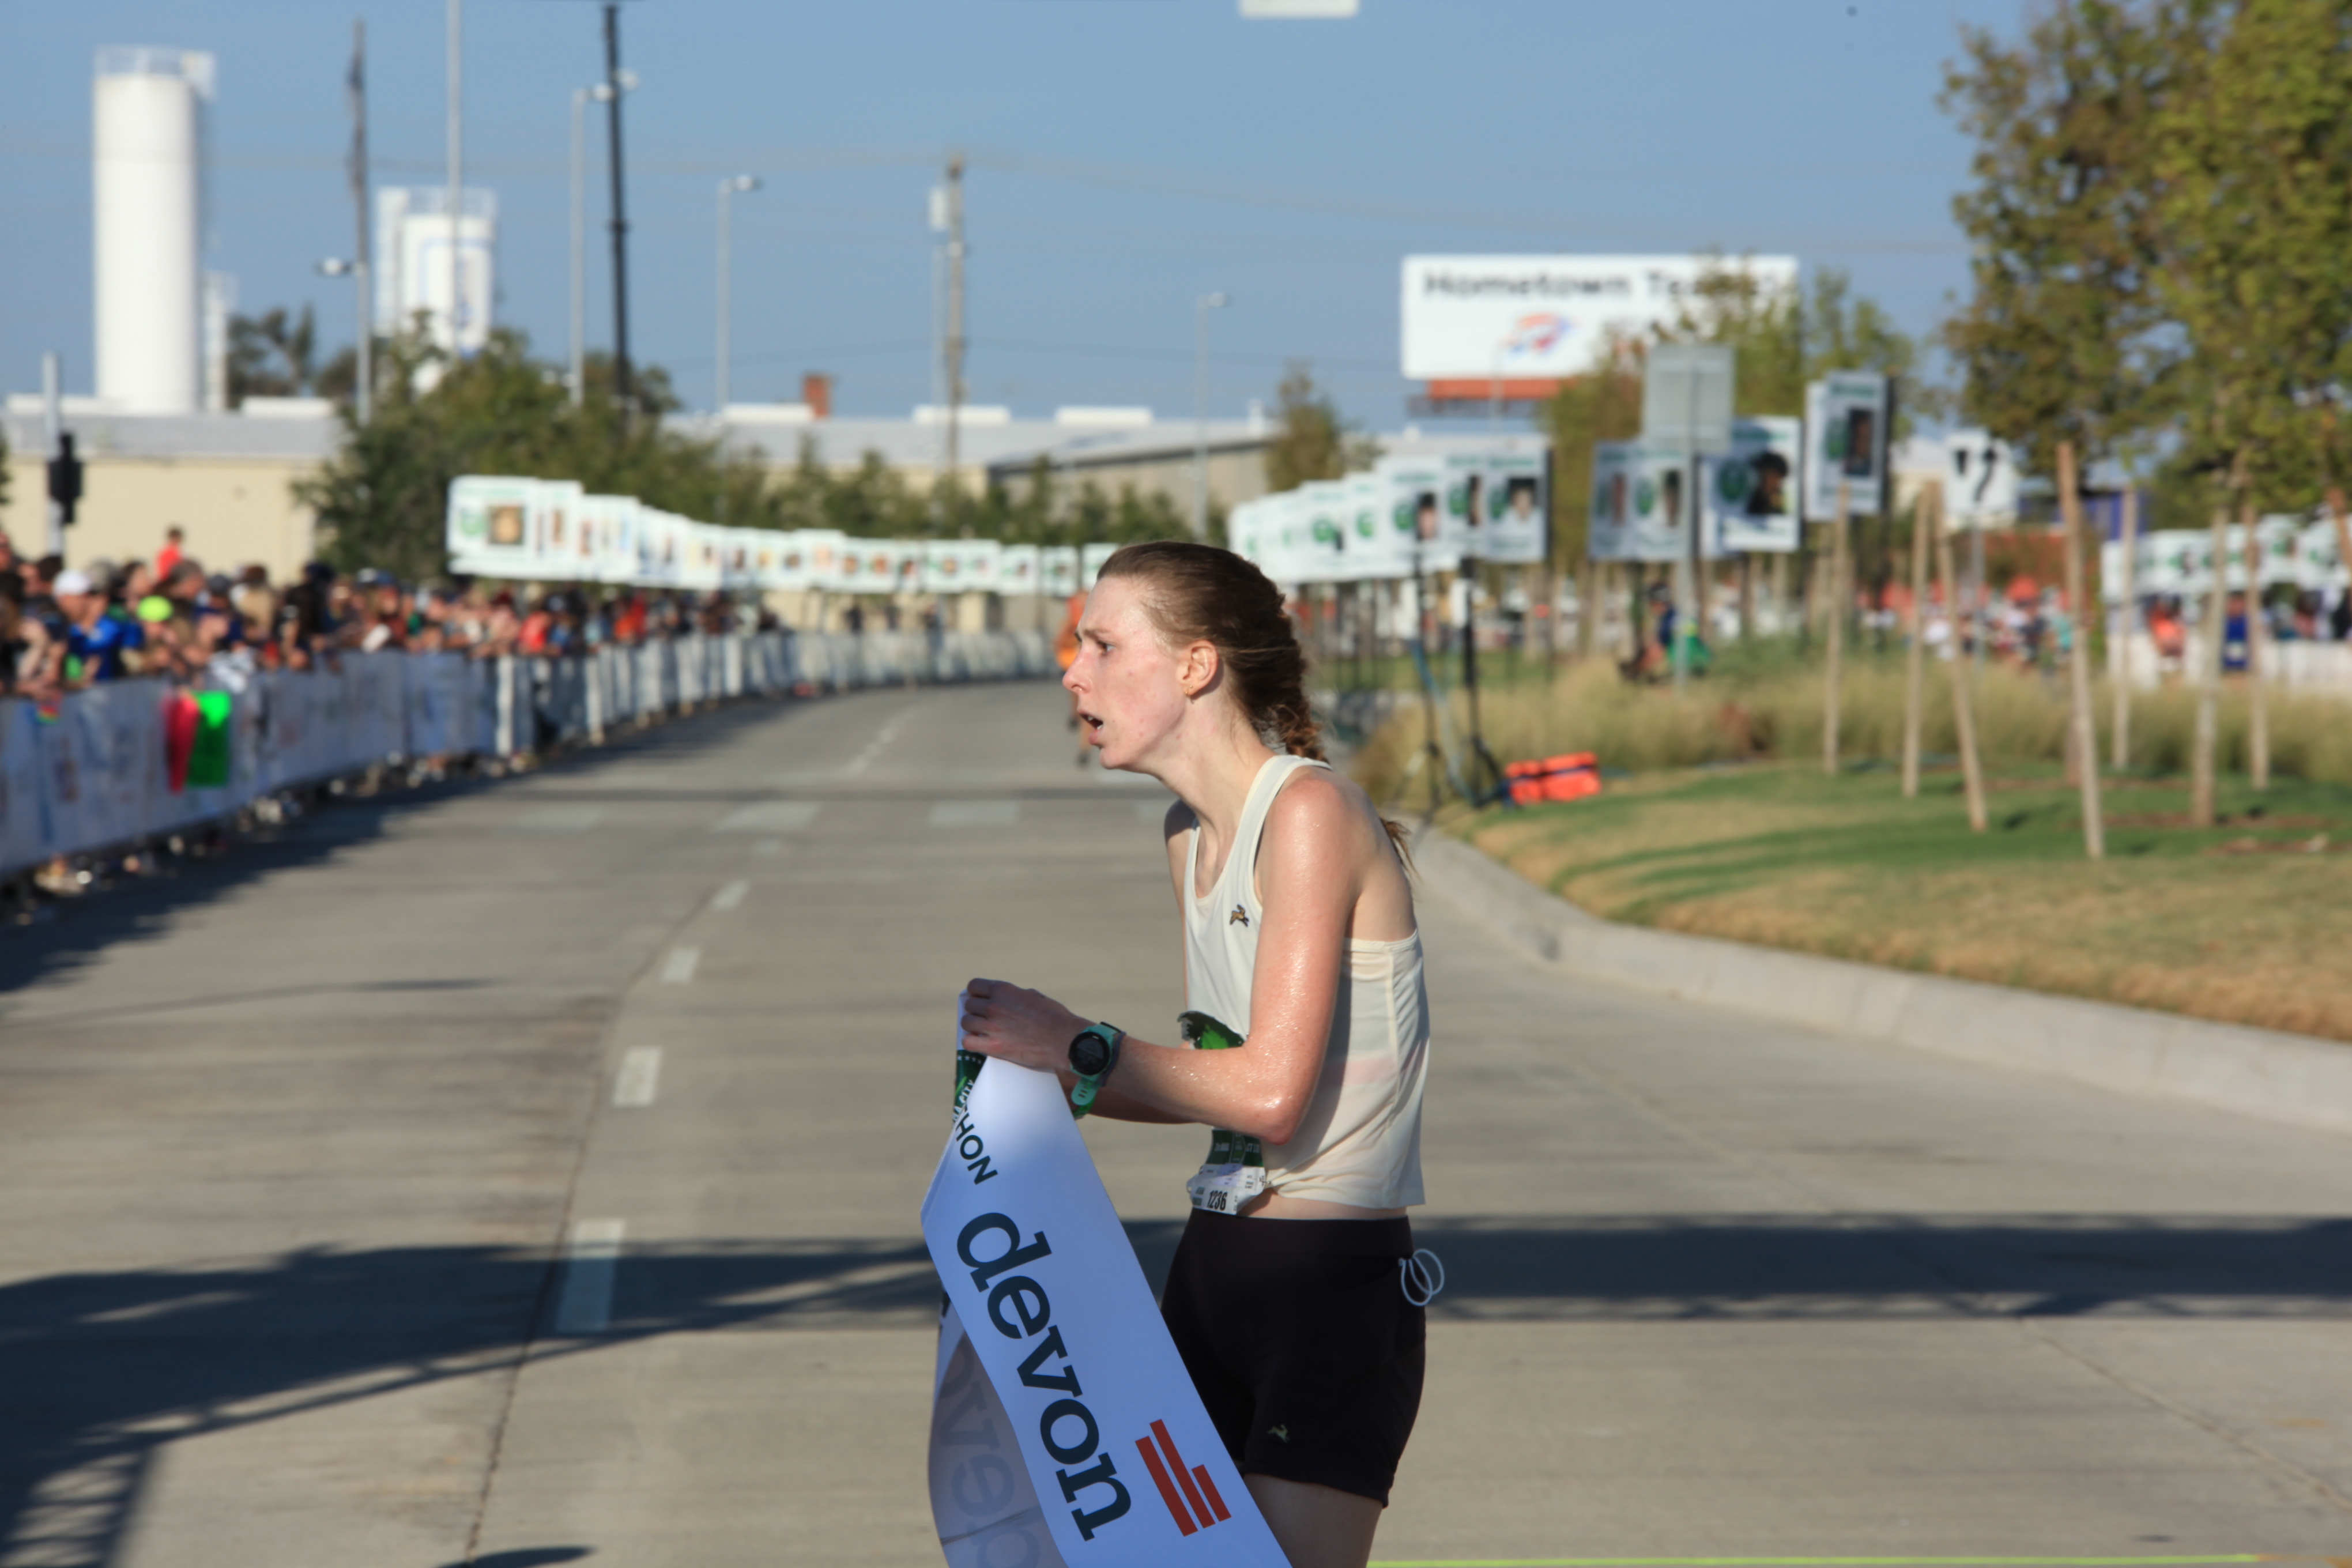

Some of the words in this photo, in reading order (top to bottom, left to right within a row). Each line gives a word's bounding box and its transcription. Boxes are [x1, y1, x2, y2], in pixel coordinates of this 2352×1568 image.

[1423, 271, 1633, 297] Hometown
[1207, 1190, 1228, 1211] 1236
[956, 1212, 1132, 1541] devon
